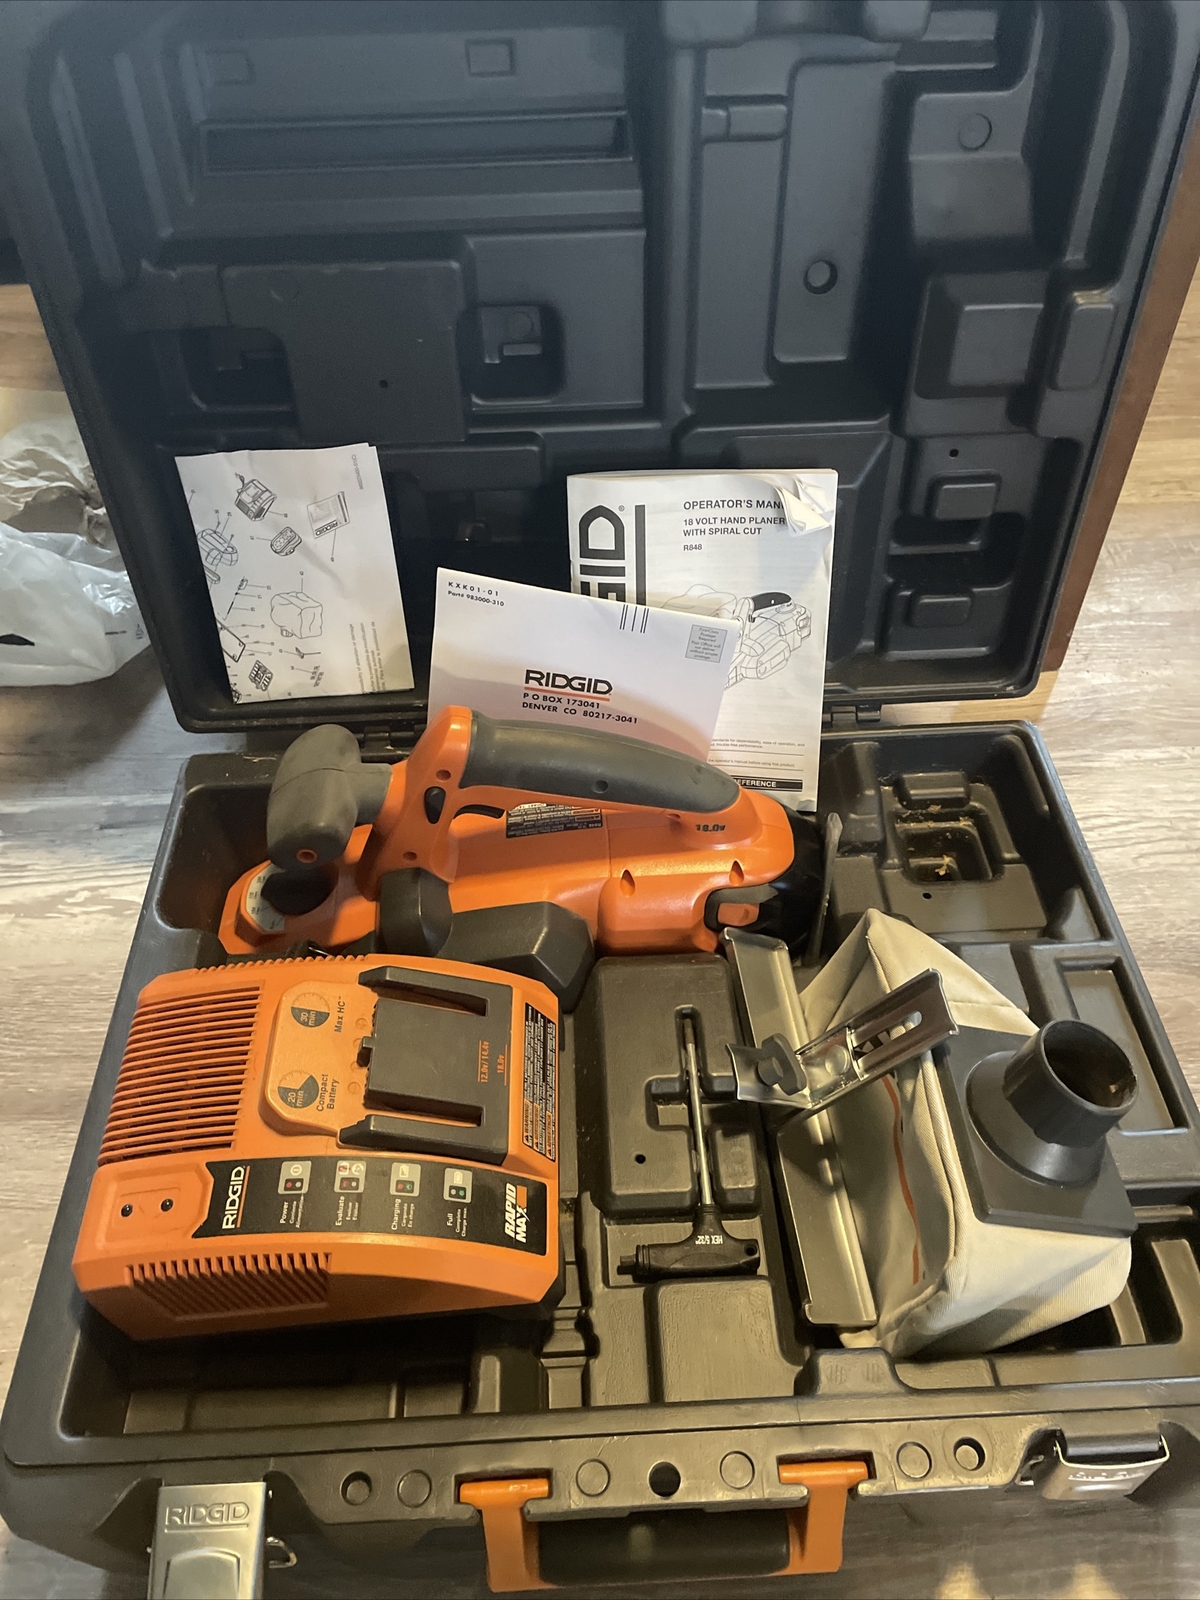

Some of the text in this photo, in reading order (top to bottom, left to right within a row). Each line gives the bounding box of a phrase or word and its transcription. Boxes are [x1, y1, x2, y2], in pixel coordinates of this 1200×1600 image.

[683, 499, 785, 510] OPERATOR'S MAN
[683, 516, 785, 527] 18 VOLT HAND PLANER
[683, 527, 762, 537] WITH SPIRAL CUT
[683, 543, 703, 552] R848
[447, 590, 505, 607] Part# 983000-310
[524, 668, 613, 696] RIDGID
[531, 692, 540, 701] O
[542, 695, 563, 704] BOX
[566, 698, 601, 709] 173041
[522, 701, 639, 724] DENVER CO 80217-3041
[300, 1012, 309, 1022] 30
[334, 1016, 344, 1033] Max
[287, 1092, 296, 1103] 20
[296, 1090, 304, 1107] min
[316, 1073, 329, 1112] Compact
[327, 1078, 340, 1110] Battery
[222, 1165, 246, 1230] RIDGID
[279, 1201, 289, 1224] Power
[335, 1195, 346, 1226] Evaluate
[391, 1198, 402, 1231] Charging
[504, 1182, 517, 1239] RAPID
[446, 1212, 454, 1227] Full
[515, 1205, 531, 1244] MAX
[711, 1234, 724, 1245] HEX
[164, 1501, 251, 1526] RIDGID
